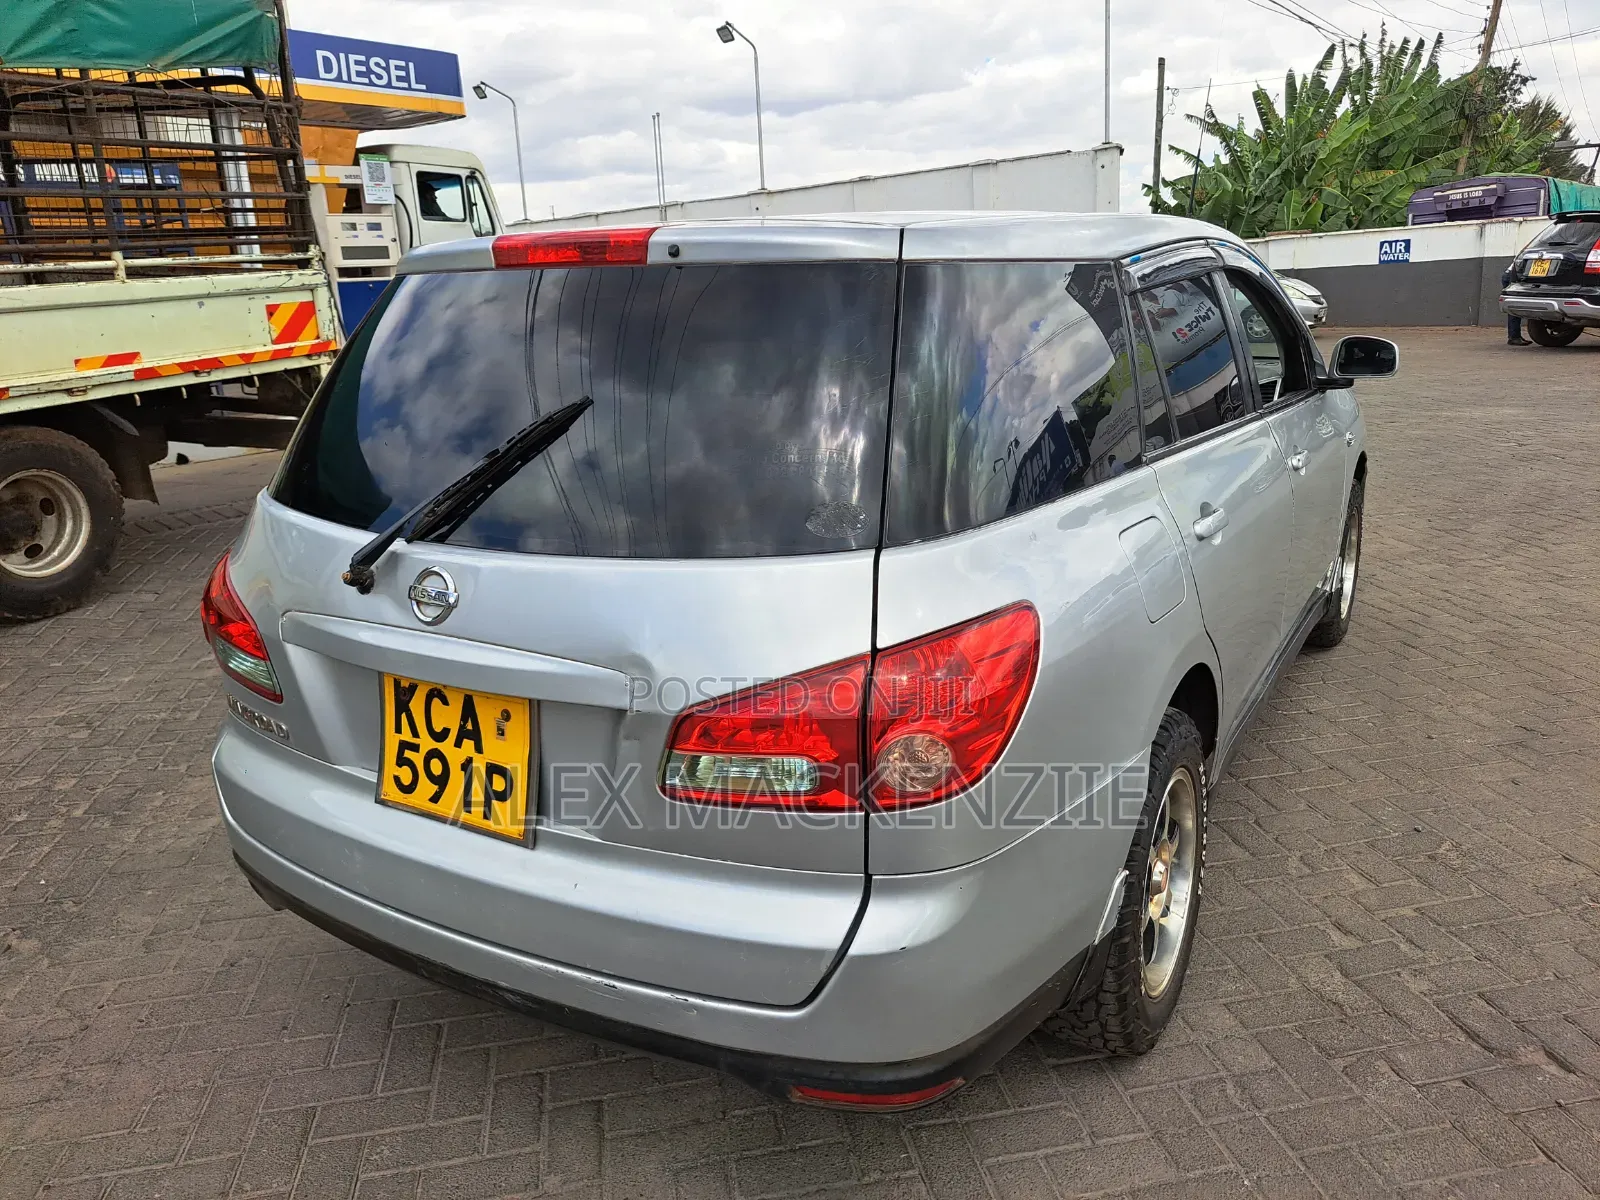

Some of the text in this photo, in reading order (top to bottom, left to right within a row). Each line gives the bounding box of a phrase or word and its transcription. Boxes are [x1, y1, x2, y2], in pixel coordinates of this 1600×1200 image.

[315, 49, 427, 90] DIESEL
[1448, 190, 1483, 201] JESUS IS LORD
[1380, 241, 1406, 254] AIR
[1380, 252, 1410, 261] WATER
[411, 585, 450, 605] NISSAN
[393, 677, 483, 755] KCA
[392, 739, 514, 820] 591P
